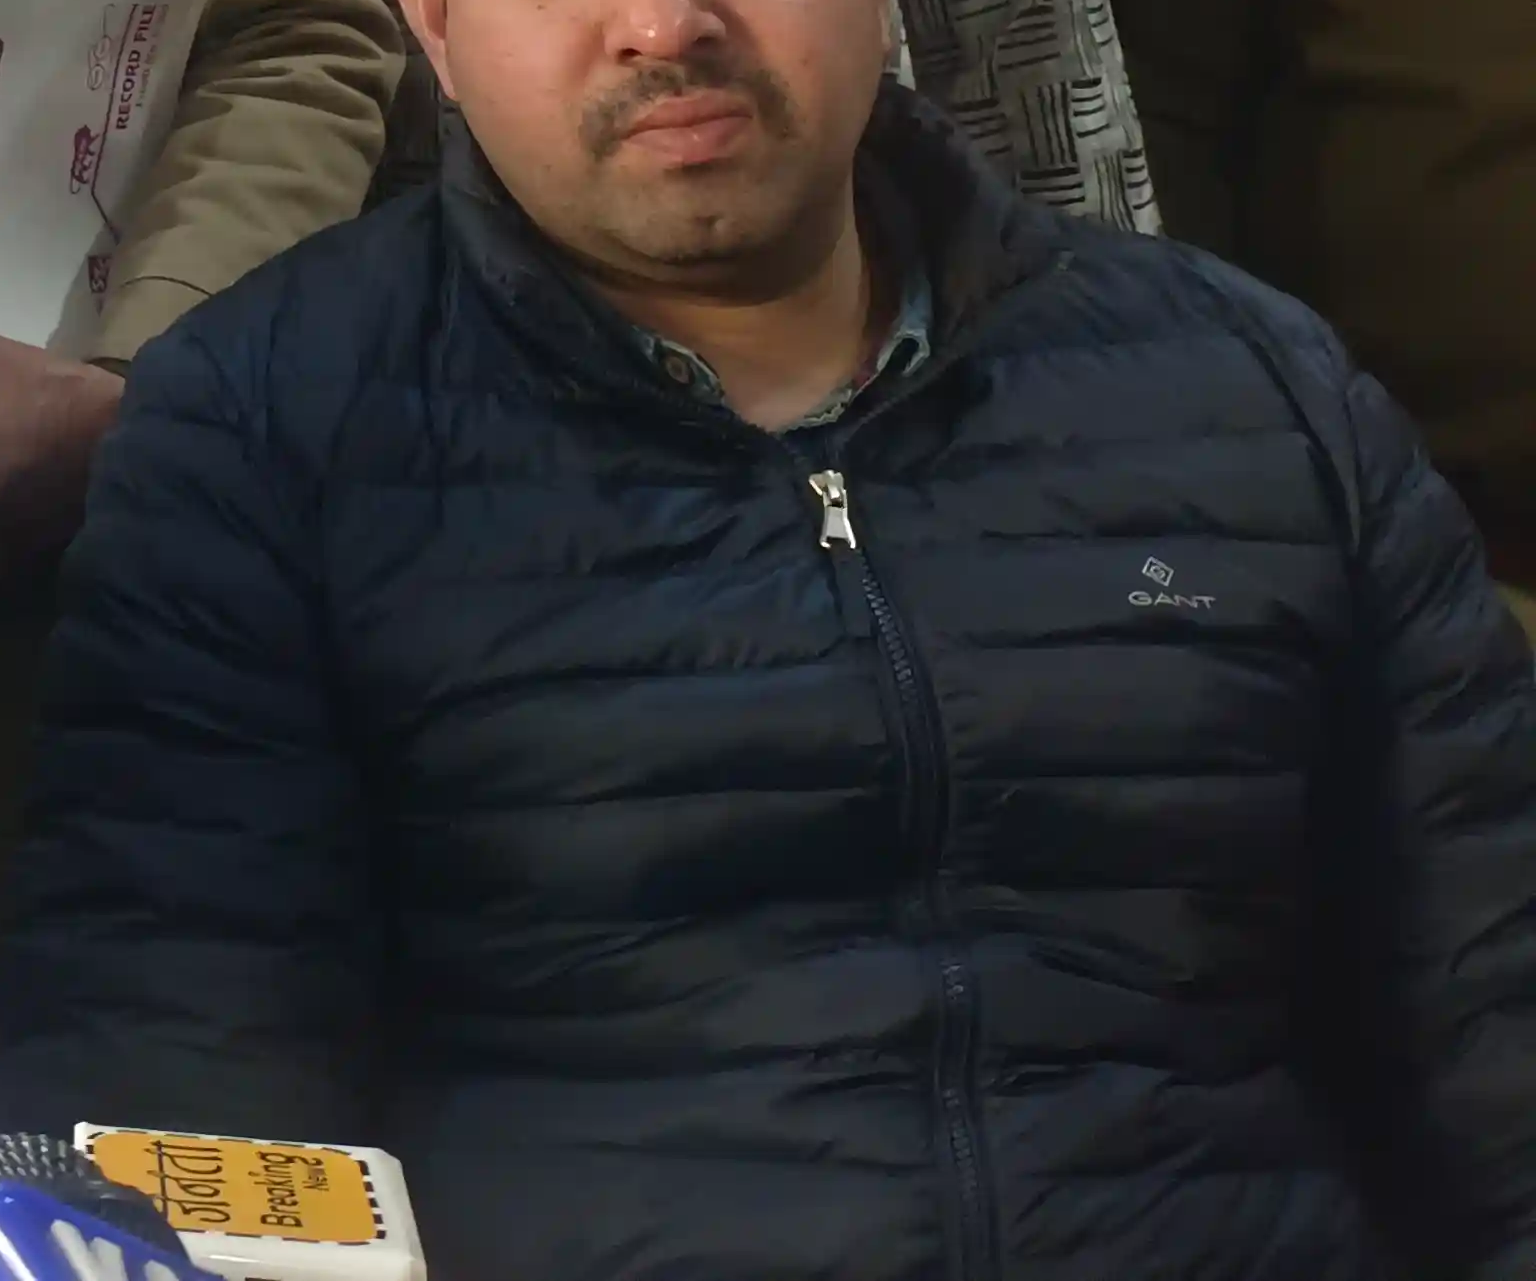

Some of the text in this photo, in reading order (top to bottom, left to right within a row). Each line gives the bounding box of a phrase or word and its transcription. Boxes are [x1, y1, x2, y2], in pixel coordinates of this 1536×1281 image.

[116, 48, 141, 130] RECORD
[1128, 591, 1216, 609] GANT
[248, 1151, 310, 1228] Breaking
